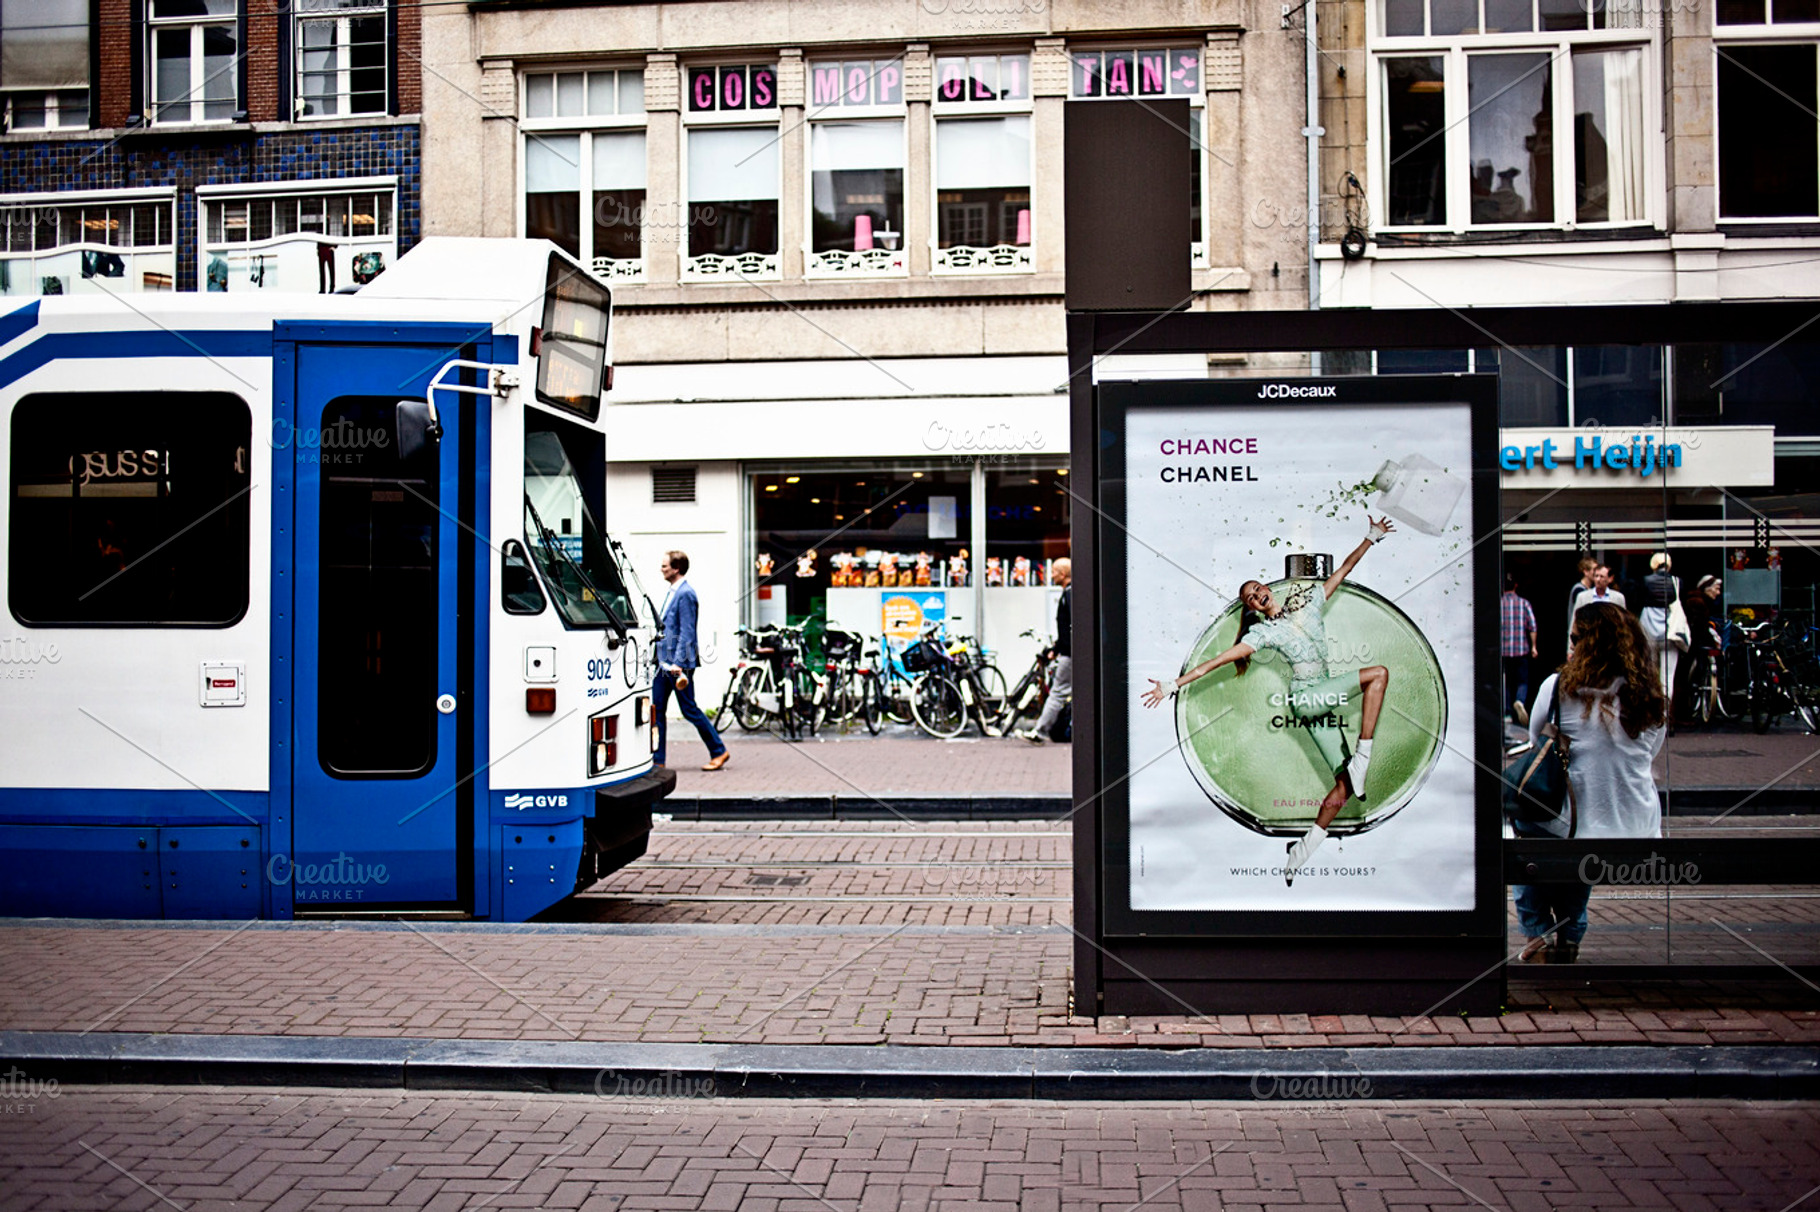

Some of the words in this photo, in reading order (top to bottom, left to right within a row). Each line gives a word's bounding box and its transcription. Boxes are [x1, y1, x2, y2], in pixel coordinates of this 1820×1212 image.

[1257, 384, 1337, 399] JCDecaux
[1160, 438, 1259, 456] CHANCE
[1574, 434, 1683, 477] Heijn
[1160, 465, 1259, 483] CHANEL
[587, 658, 612, 681] 902
[1270, 692, 1349, 706] CHANCE
[1270, 715, 1349, 729] CHANEL
[535, 795, 569, 808] GVB
[1273, 799, 1296, 808] EAU
[1230, 867, 1267, 877] WHICH
[1271, 867, 1316, 877] CHANCE
[1320, 867, 1329, 877] IS
